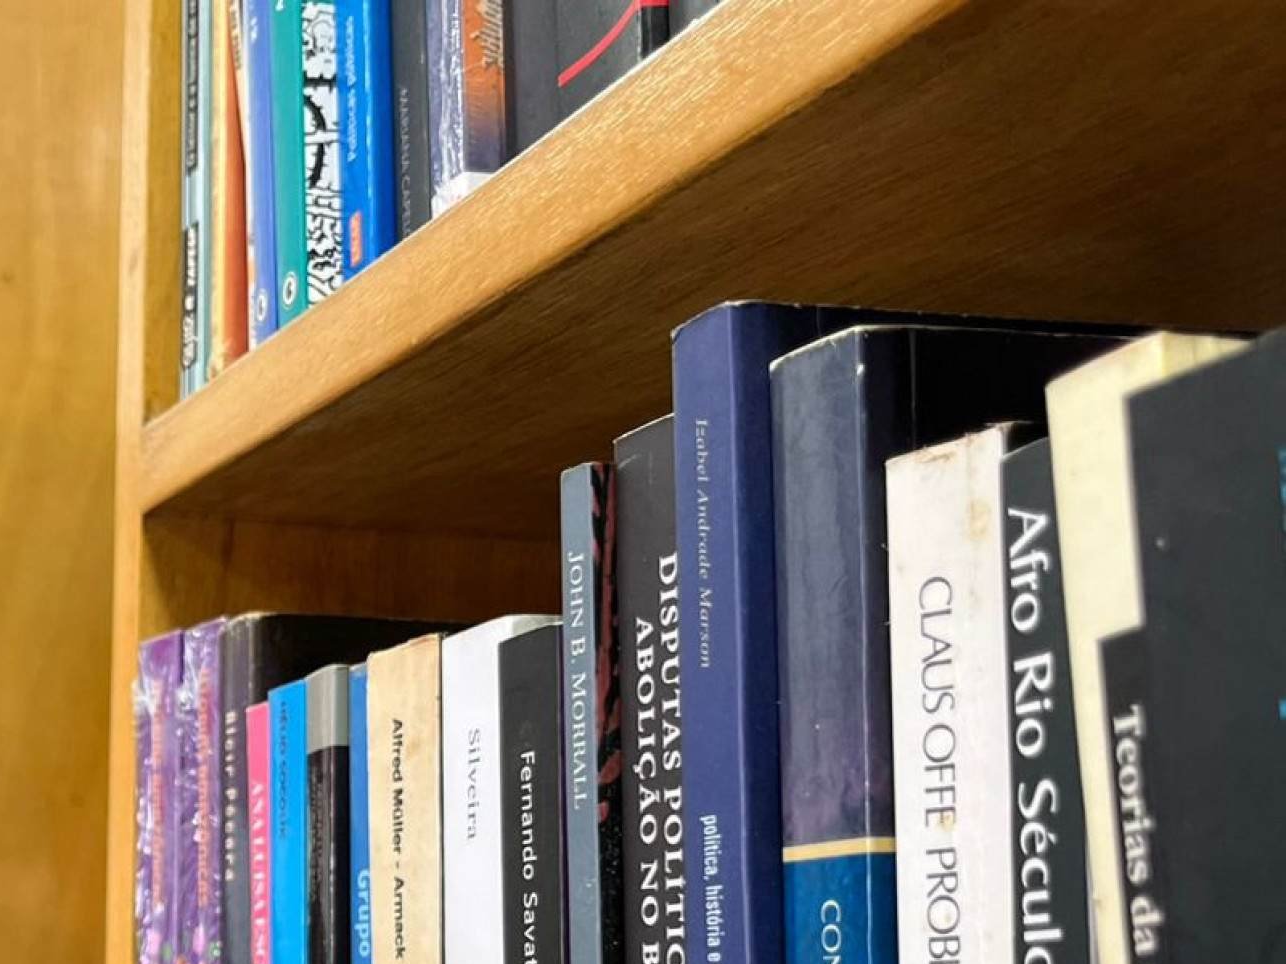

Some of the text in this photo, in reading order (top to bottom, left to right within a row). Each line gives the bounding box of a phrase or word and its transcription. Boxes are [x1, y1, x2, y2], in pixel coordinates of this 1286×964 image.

[695, 418, 714, 669] Izabel Andrade Marson
[1007, 507, 1051, 633] Afro
[569, 636, 586, 665] B.
[657, 551, 684, 770] DISPUTAS
[918, 577, 955, 714] CLAUS
[391, 719, 404, 782] Alfred
[632, 617, 661, 845] ABOLIÇÃO
[1012, 652, 1054, 757] Rio
[392, 788, 405, 855] Müller
[466, 728, 483, 840] Silveira
[519, 752, 536, 880] Fernando
[922, 724, 957, 827] OFFE
[1113, 706, 1156, 882] Teorias
[639, 861, 659, 926] NO
[699, 815, 723, 881] política,
[354, 870, 371, 958] Grupo
[393, 876, 406, 960] Armack
[703, 886, 725, 949] história
[705, 952, 718, 963] e
[1128, 897, 1163, 955] da
